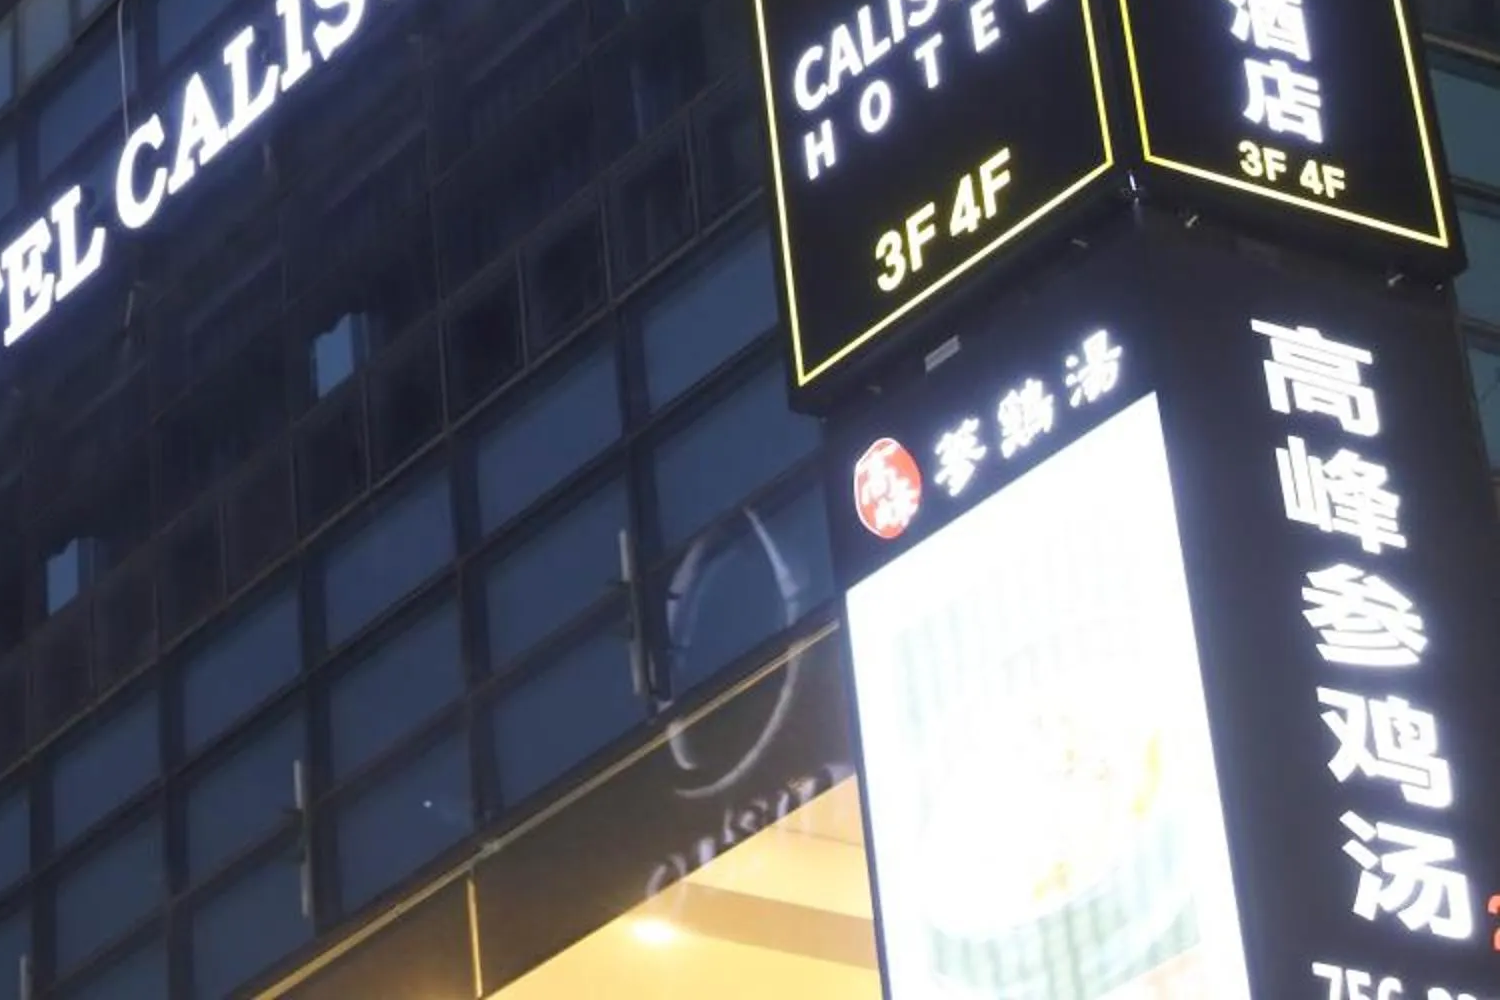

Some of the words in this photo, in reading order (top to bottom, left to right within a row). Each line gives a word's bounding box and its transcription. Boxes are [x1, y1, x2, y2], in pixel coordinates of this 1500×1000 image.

[875, 202, 936, 292] 3F
[950, 147, 1011, 238] 4F
[1238, 140, 1287, 182] 3F
[1299, 159, 1345, 199] 4F
[1251, 318, 1474, 939] 高峰参鸡汤
